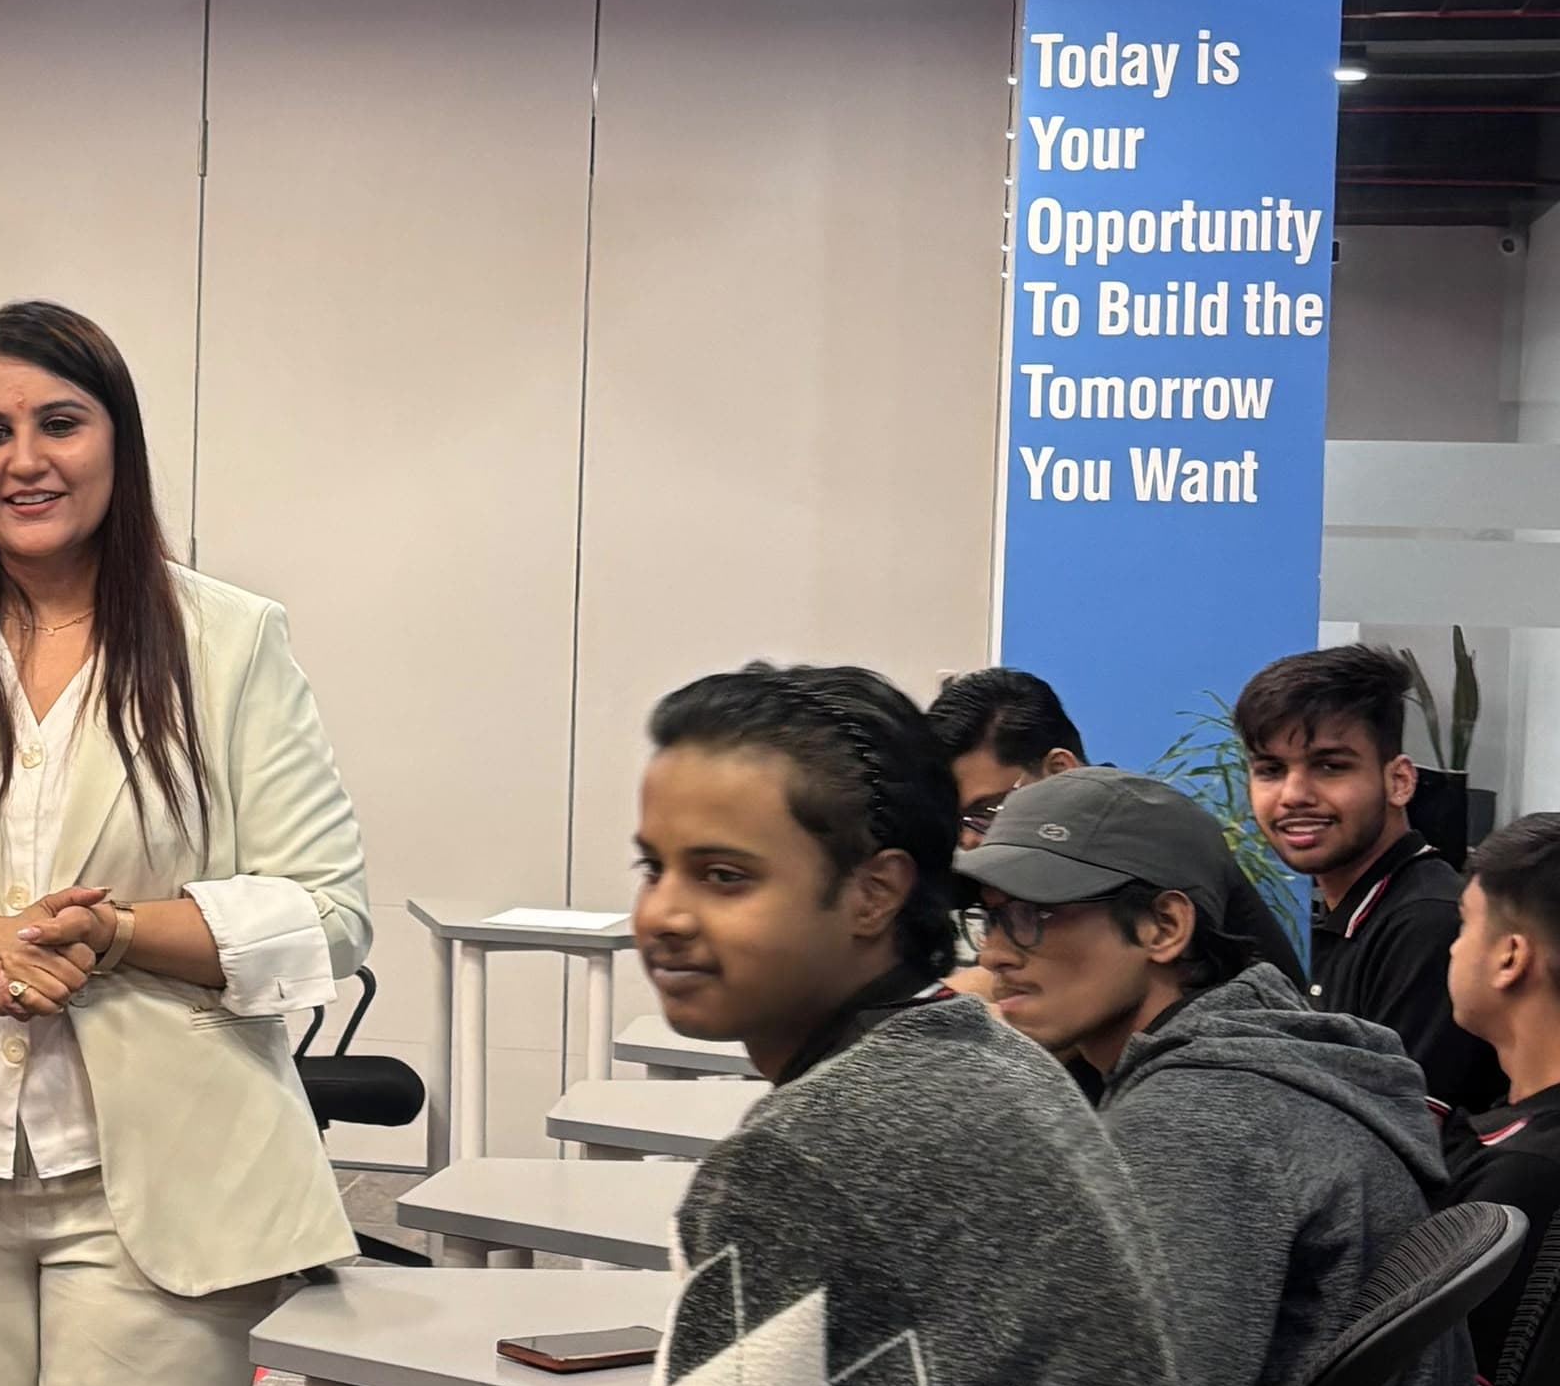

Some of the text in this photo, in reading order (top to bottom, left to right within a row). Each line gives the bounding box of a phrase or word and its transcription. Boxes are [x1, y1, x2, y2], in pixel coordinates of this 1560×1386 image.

[1030, 29, 1241, 99] Today is
[1028, 115, 1145, 172] Your
[1026, 196, 1323, 266] Opportunity
[1023, 280, 1324, 337] To Build the
[1020, 364, 1274, 420] Tomorrow
[1019, 446, 1259, 503] You Want
